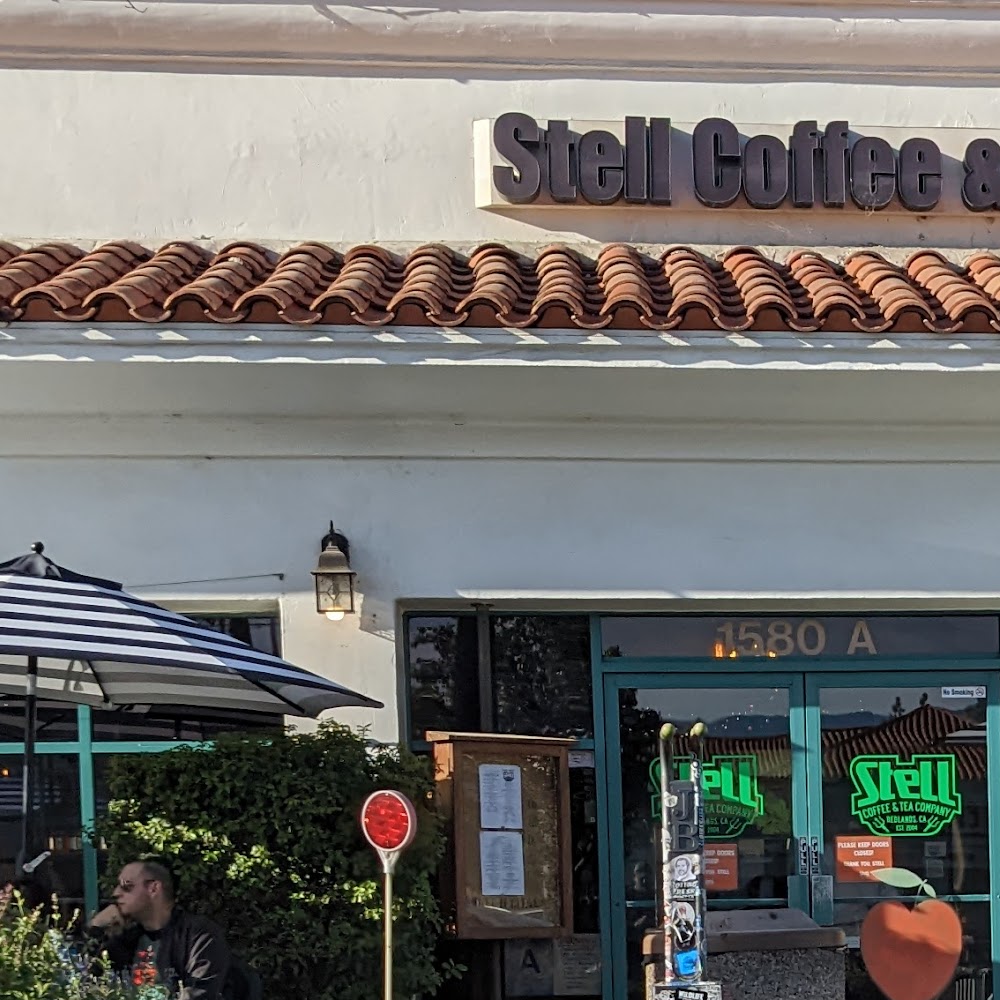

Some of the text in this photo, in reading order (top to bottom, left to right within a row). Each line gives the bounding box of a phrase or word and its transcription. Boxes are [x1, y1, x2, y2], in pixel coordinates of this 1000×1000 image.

[493, 112, 671, 205] Stell
[692, 117, 942, 211] Coffee
[716, 619, 878, 657] 1580 A
[943, 688, 975, 697] No Smoking
[855, 760, 957, 808] Stell
[862, 801, 952, 818] COFFEE & TEA COMPANY
[918, 815, 927, 823] CA
[811, 838, 819, 866] PULL
[520, 948, 541, 974] A
